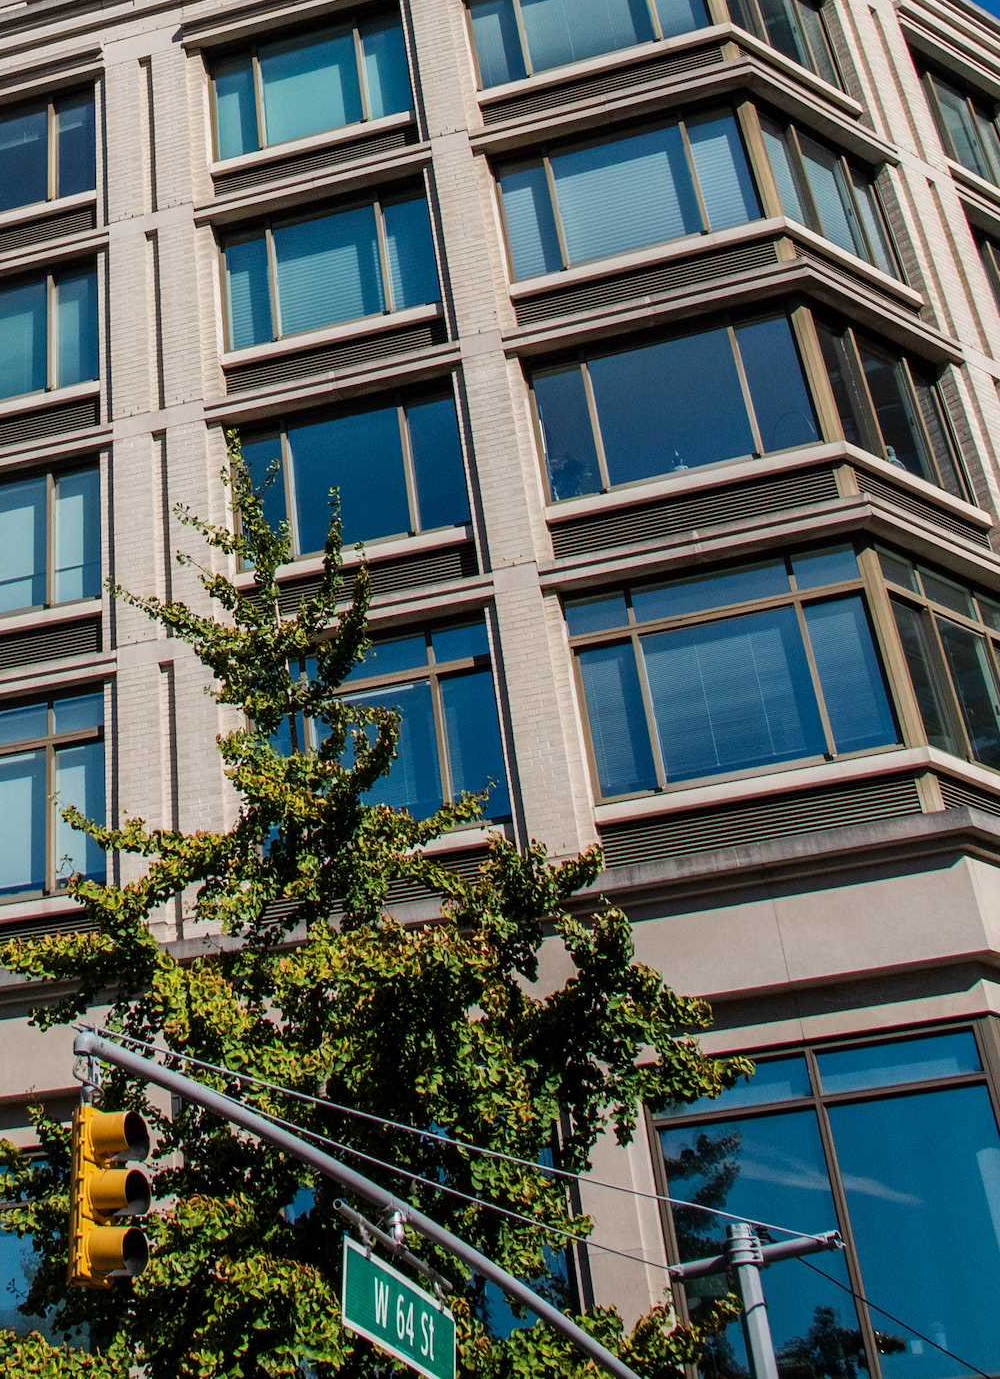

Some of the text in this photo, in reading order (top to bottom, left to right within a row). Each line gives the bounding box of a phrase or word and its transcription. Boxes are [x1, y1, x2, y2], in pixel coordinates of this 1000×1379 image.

[374, 1276, 435, 1362] W 64 St
